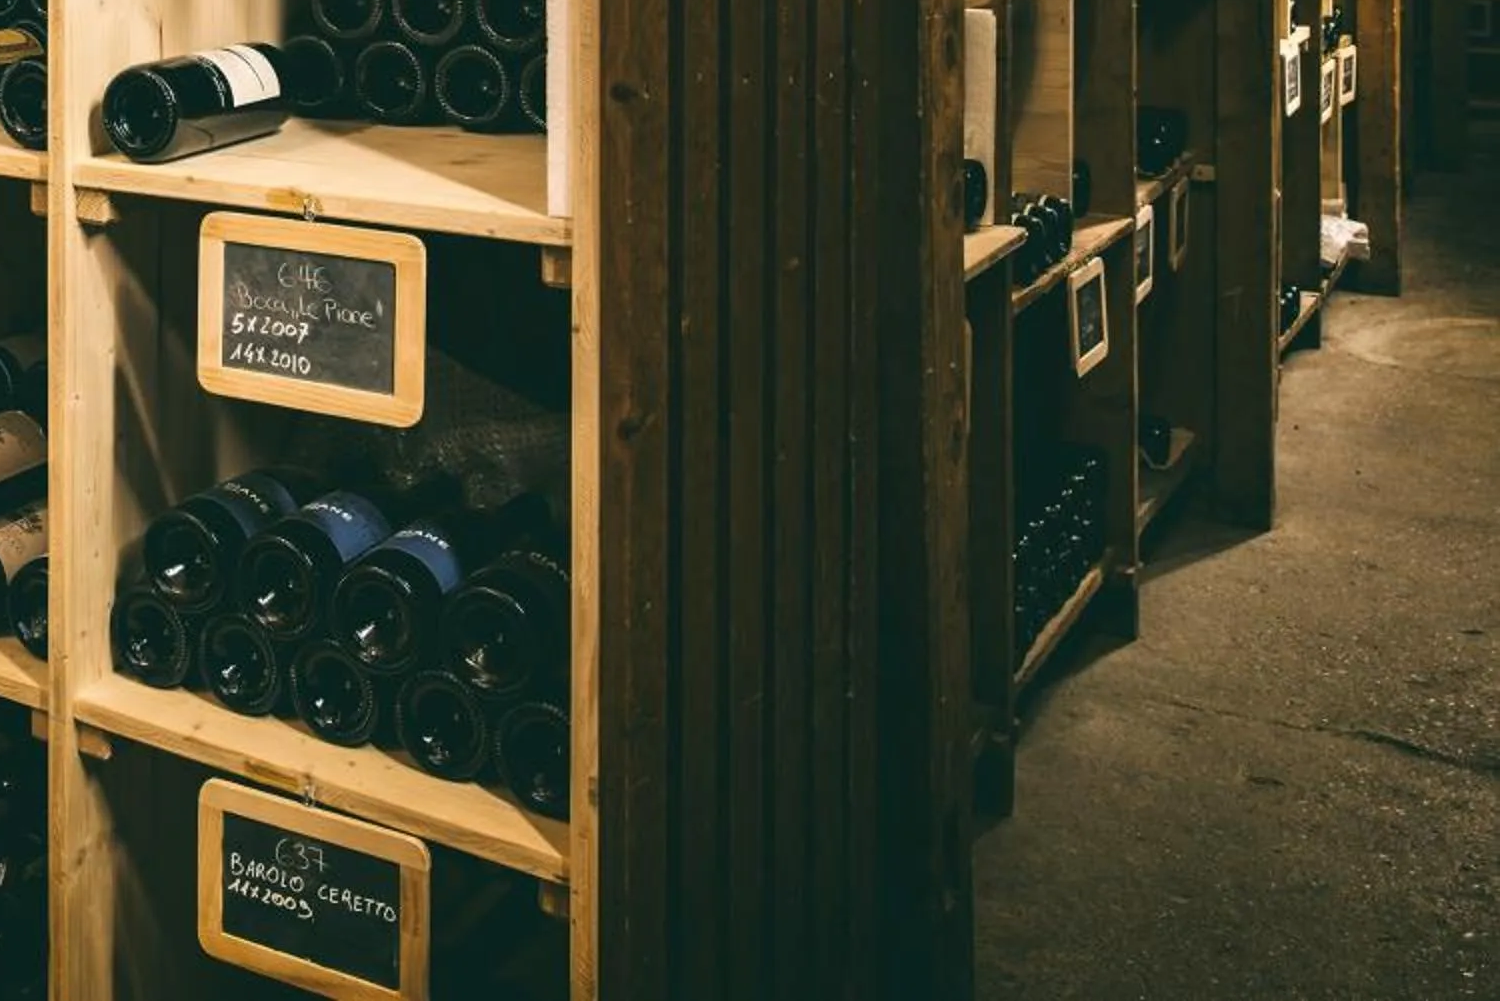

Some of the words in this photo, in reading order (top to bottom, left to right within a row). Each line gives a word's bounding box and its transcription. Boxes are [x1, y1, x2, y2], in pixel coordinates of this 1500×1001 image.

[275, 838, 329, 873] 637
[230, 852, 304, 893] BAROLO
[317, 884, 397, 922] CERETTO
